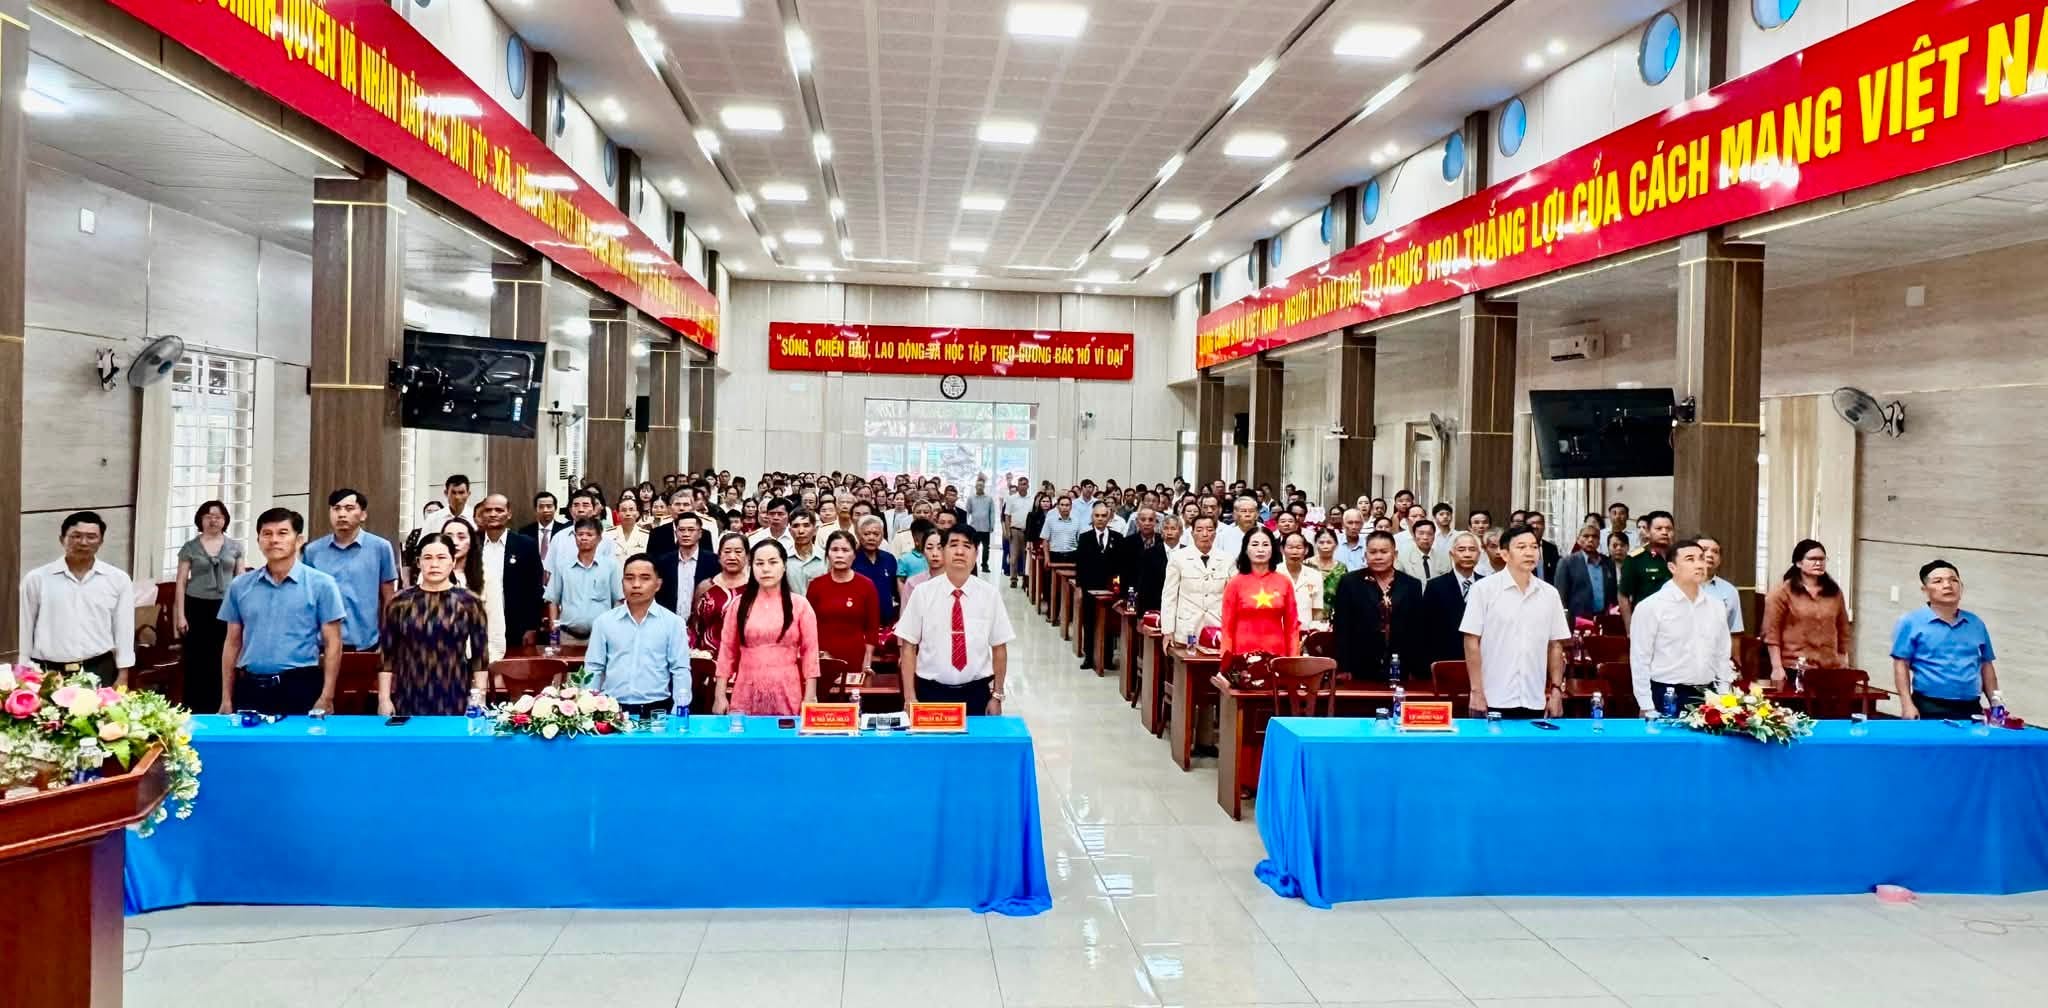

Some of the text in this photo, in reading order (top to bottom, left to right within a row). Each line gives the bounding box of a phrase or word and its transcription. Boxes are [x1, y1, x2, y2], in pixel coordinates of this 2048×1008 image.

[340, 21, 357, 96] VÀ
[361, 41, 398, 124] NHÂN
[400, 70, 425, 142] DÂN
[472, 123, 489, 189] TỘC
[1285, 283, 1310, 328] NGƯỜI
[1311, 277, 1337, 317] LÃNH
[1368, 243, 1384, 299] TỔ
[1386, 242, 1423, 290] CHỨC
[1427, 232, 1459, 284] MỌI
[1463, 200, 1525, 268] THẮNG
[1531, 187, 1566, 254] LỢI
[1571, 152, 1622, 233] CỦA
[1629, 141, 1710, 217] CÁCH
[1719, 86, 1842, 190] MẠNG
[1858, 34, 1970, 144] VIỆT
[815, 335, 845, 357] CHIẾN
[875, 341, 894, 359] LAO
[898, 339, 925, 362] ĐỘNG
[968, 341, 987, 364] TẬP
[991, 344, 1015, 362] THEO
[1055, 344, 1074, 364] BÁC
